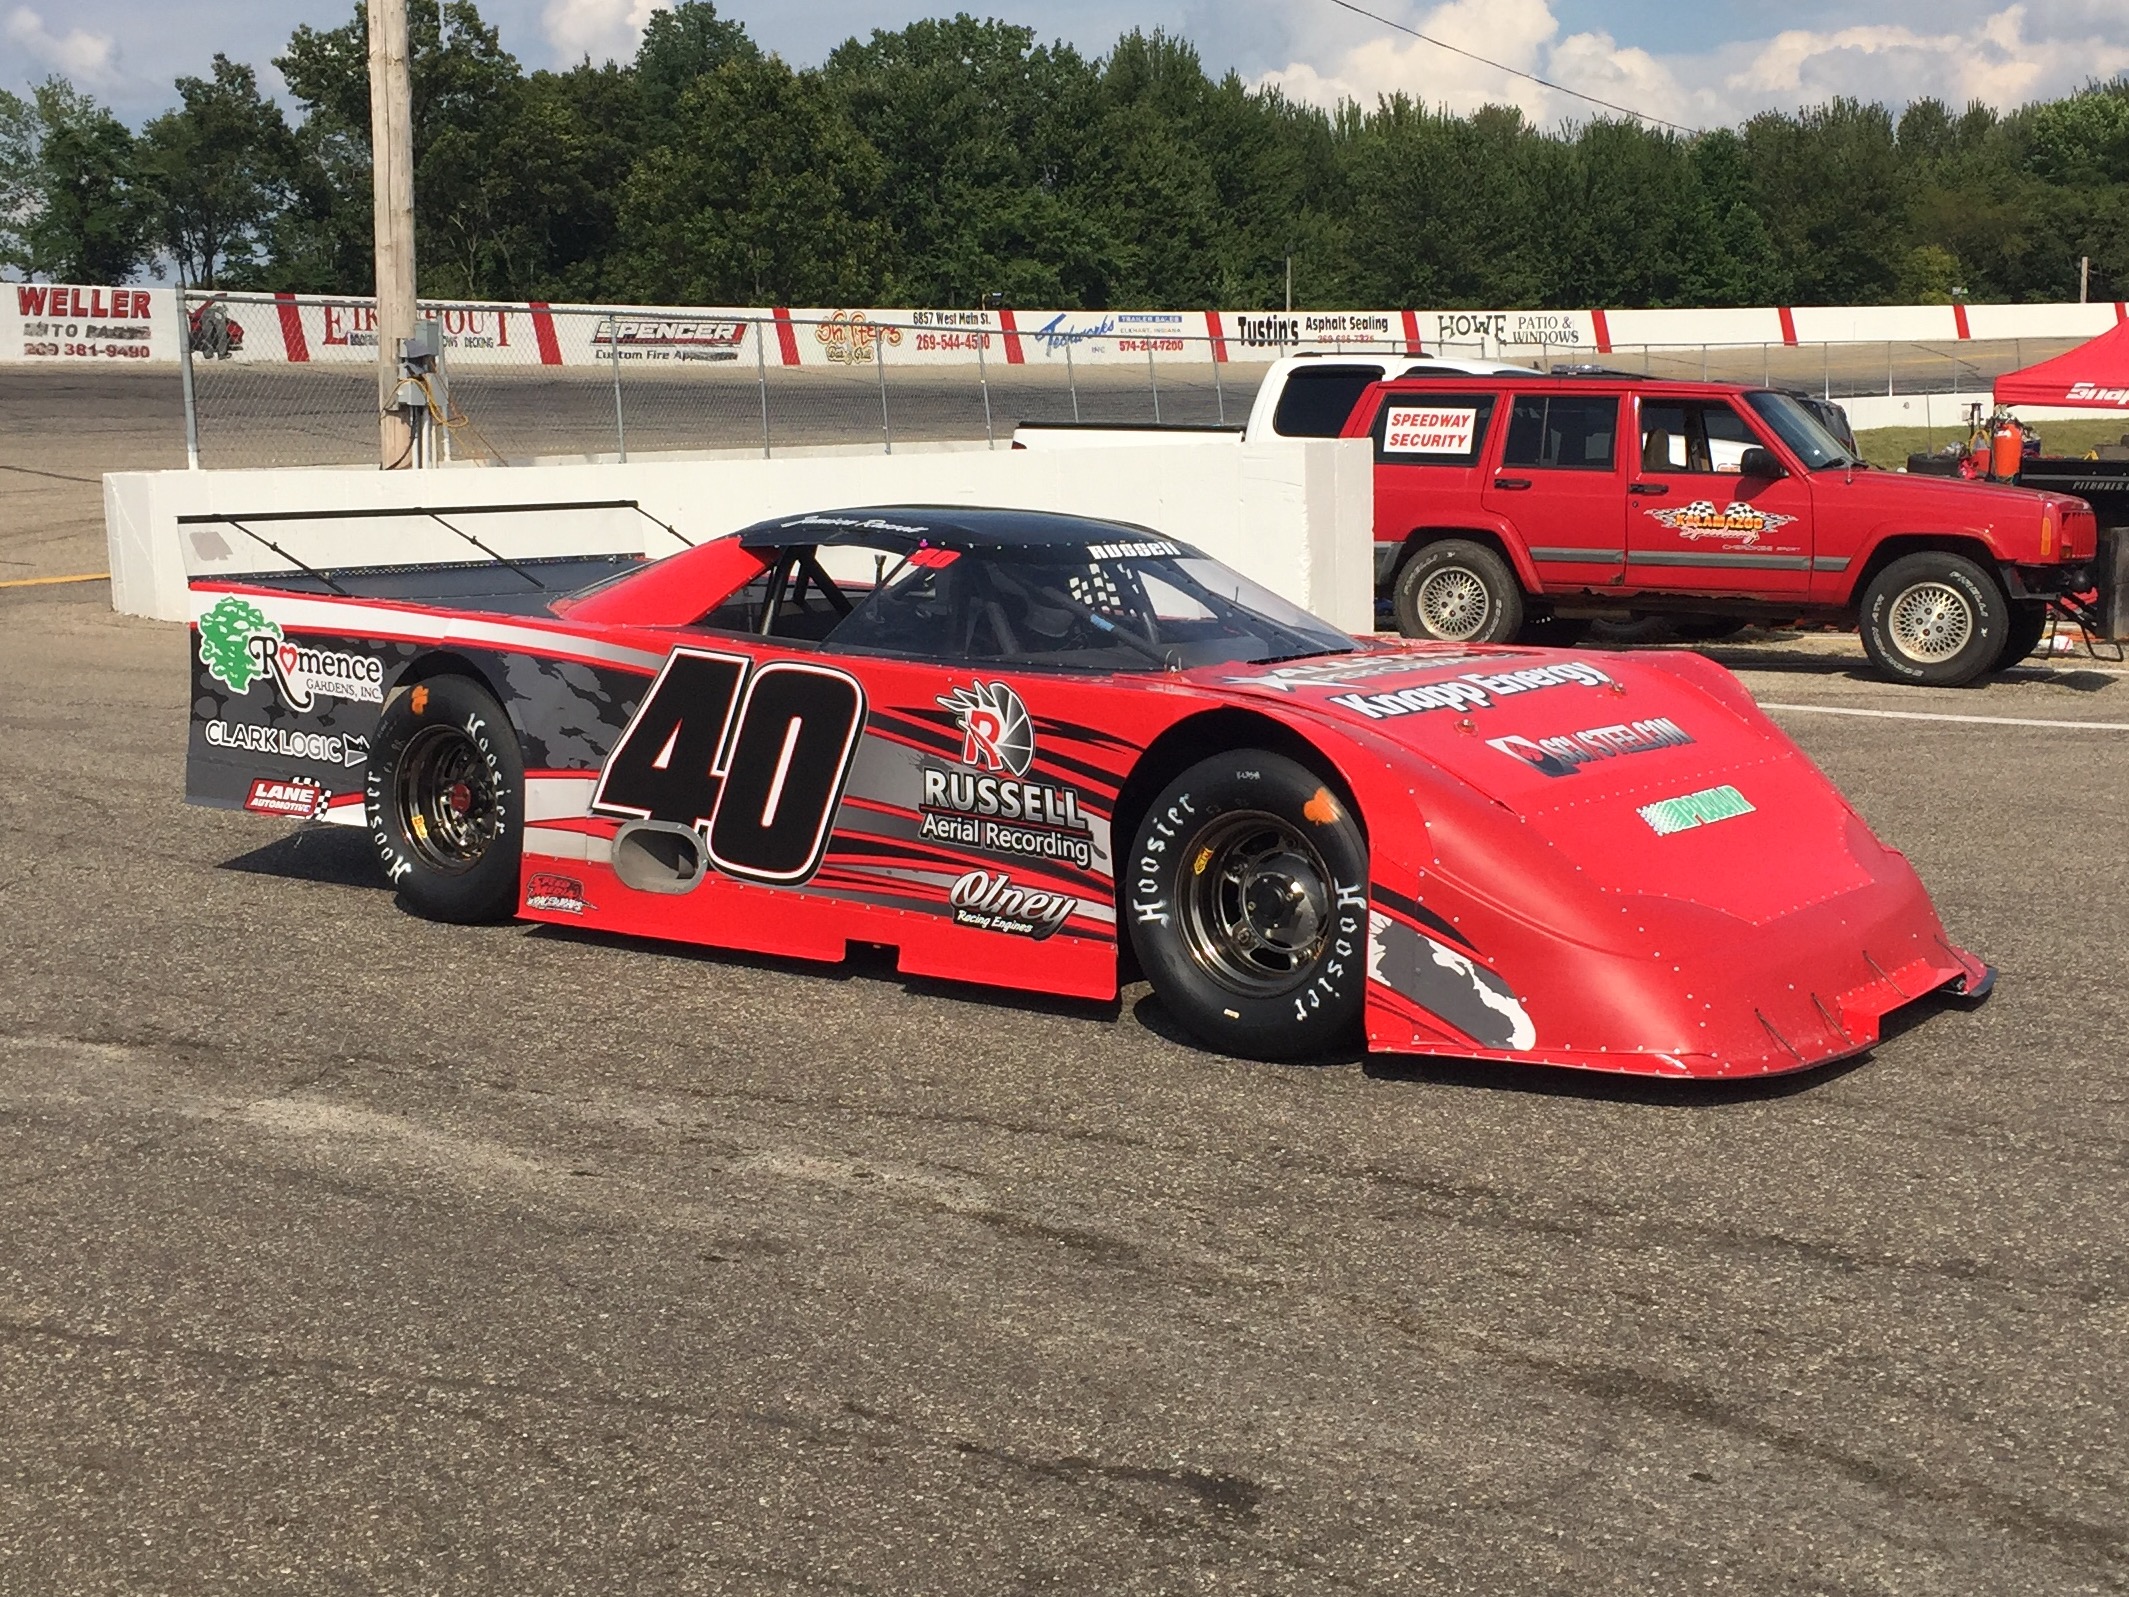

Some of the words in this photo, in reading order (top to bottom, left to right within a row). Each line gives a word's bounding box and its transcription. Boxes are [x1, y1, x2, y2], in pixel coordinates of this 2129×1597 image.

[17, 286, 152, 319] WELLER
[913, 312, 933, 325] 6857
[936, 312, 957, 325] West
[958, 312, 979, 325] Main
[980, 313, 992, 325] St.
[1305, 316, 1347, 333] Asphalt
[1349, 315, 1389, 333] Sealing
[1518, 316, 1558, 330] PATIO
[1561, 316, 1573, 329] &
[596, 322, 739, 340] SPENCER
[1237, 314, 1299, 347] Tustin's
[1437, 314, 1507, 346] HOWE
[1513, 330, 1580, 344] WINDOWS
[595, 349, 643, 361] Cutom
[646, 350, 670, 360] Fire
[1391, 413, 1471, 428] SPEEDWAY
[1389, 433, 1468, 448] SECURITY
[1675, 514, 1764, 530] KALAMAZOO
[907, 547, 962, 569] 40
[306, 678, 358, 697] GARDENS,
[360, 685, 382, 700] INC.
[465, 712, 512, 835] Hoosier
[590, 646, 867, 885] 40
[250, 797, 312, 812] AUTOMOTIVE
[255, 783, 316, 804] LANE
[923, 768, 1088, 831] RUSSELL
[367, 771, 413, 884] Hoosier
[922, 813, 979, 844] Aerial
[986, 822, 1090, 867] Recording
[1133, 792, 1196, 928] Hoosier
[950, 870, 1078, 938] Olney
[957, 909, 992, 929] Racing
[991, 916, 1034, 933] Engines
[1294, 877, 1368, 1022] Hoosier
